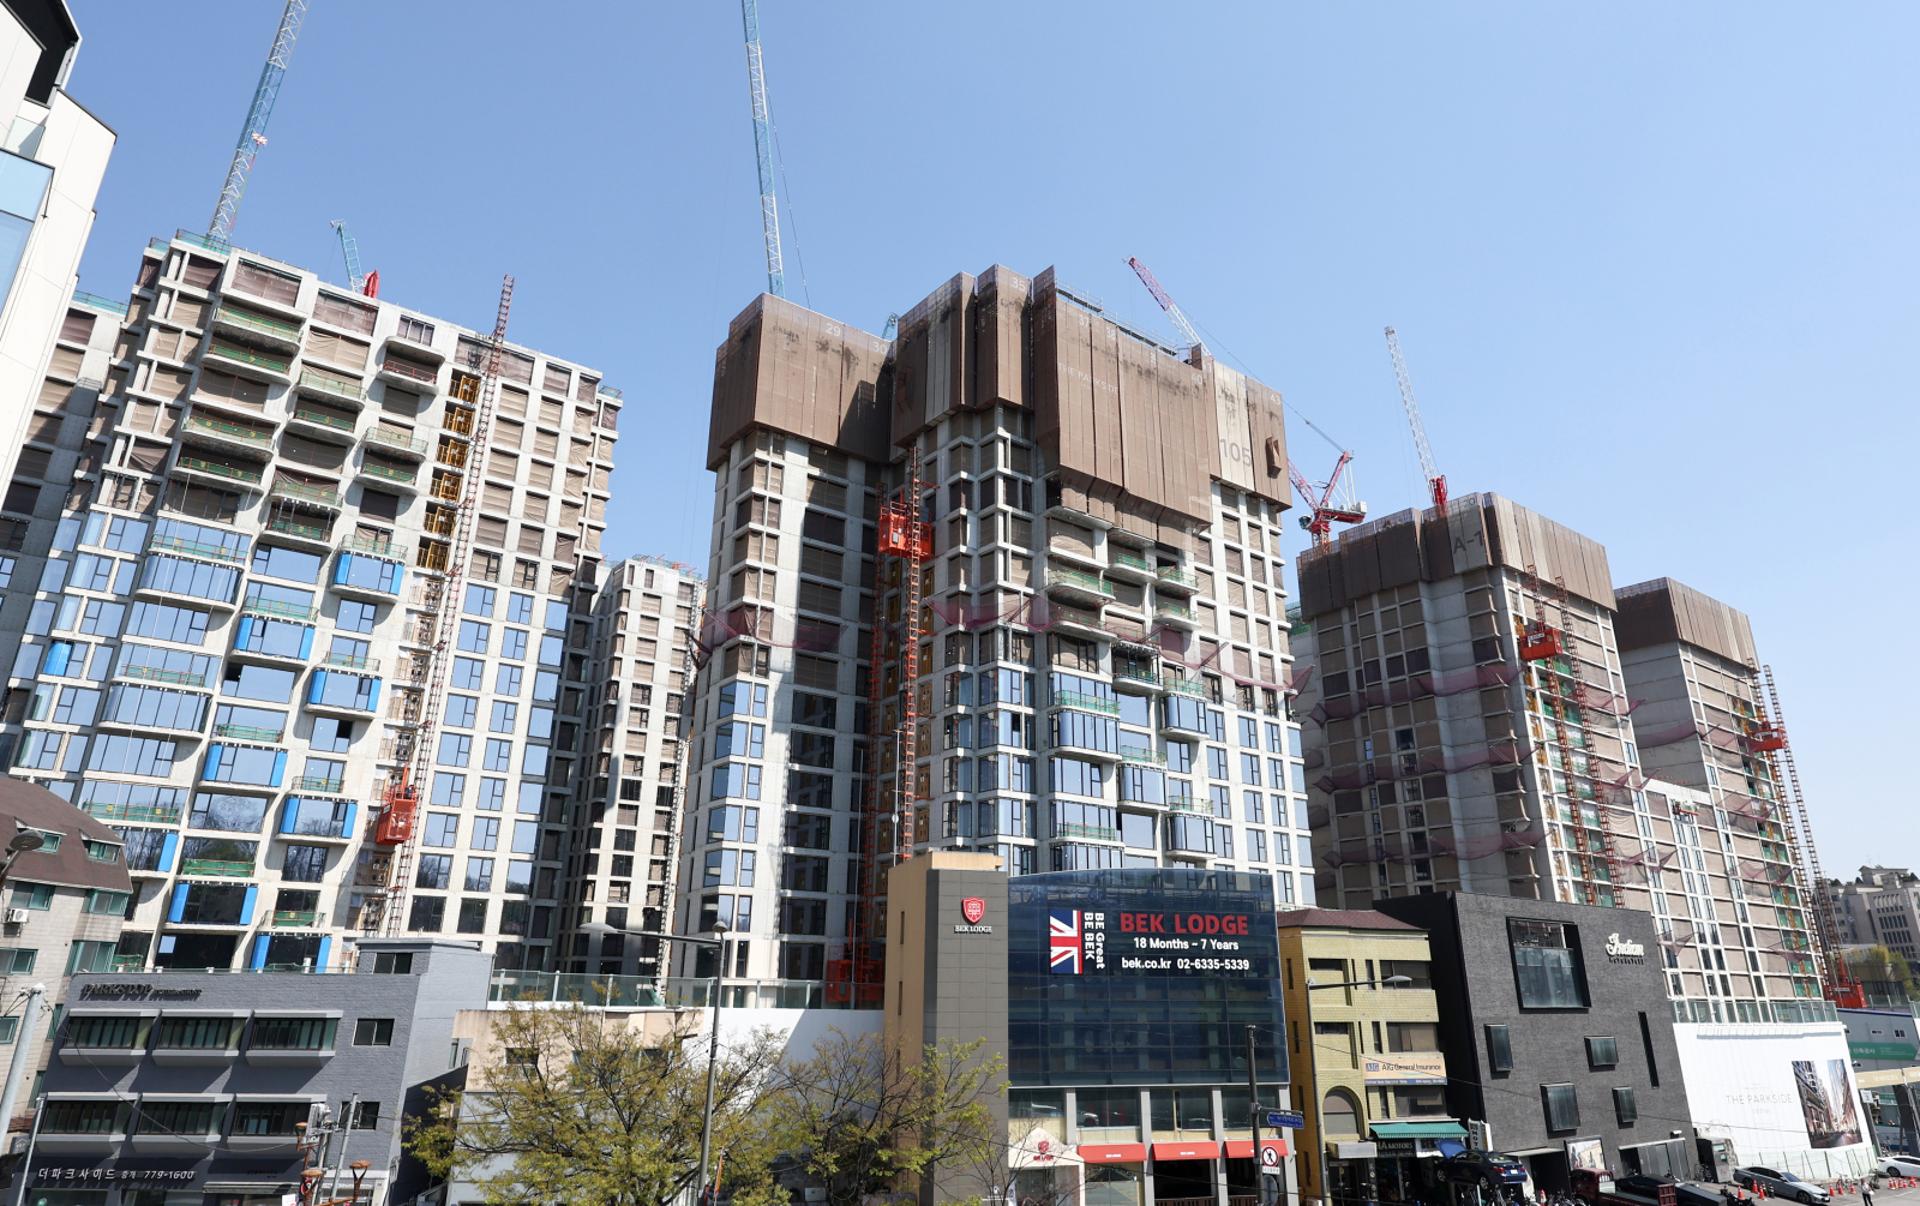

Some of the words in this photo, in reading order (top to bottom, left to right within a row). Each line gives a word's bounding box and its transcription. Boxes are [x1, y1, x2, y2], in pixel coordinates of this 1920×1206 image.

[1010, 277, 1026, 292] 35
[825, 322, 841, 338] 29
[870, 341, 889, 356] 30
[1219, 438, 1252, 467] 105
[954, 923, 969, 933] BEK
[1084, 912, 1094, 930] BE
[1095, 912, 1105, 930] BE
[1119, 912, 1165, 933] BEK
[1174, 914, 1249, 936] LODGE
[1085, 932, 1095, 960] BEK
[1096, 932, 1105, 969] Great
[1133, 937, 1147, 949] 18
[1149, 937, 1189, 950] Months
[1200, 938, 1206, 950] 7
[1209, 938, 1239, 951] Years
[1121, 957, 1172, 969] bek.co.kr
[1177, 958, 1250, 970] 02-6335-5339
[1725, 1093, 1745, 1105] THE
[1747, 1093, 1793, 1105] PARKSIDE
[38, 1168, 117, 1180] 더파크사이드
[143, 1170, 195, 1180] 779-1600
